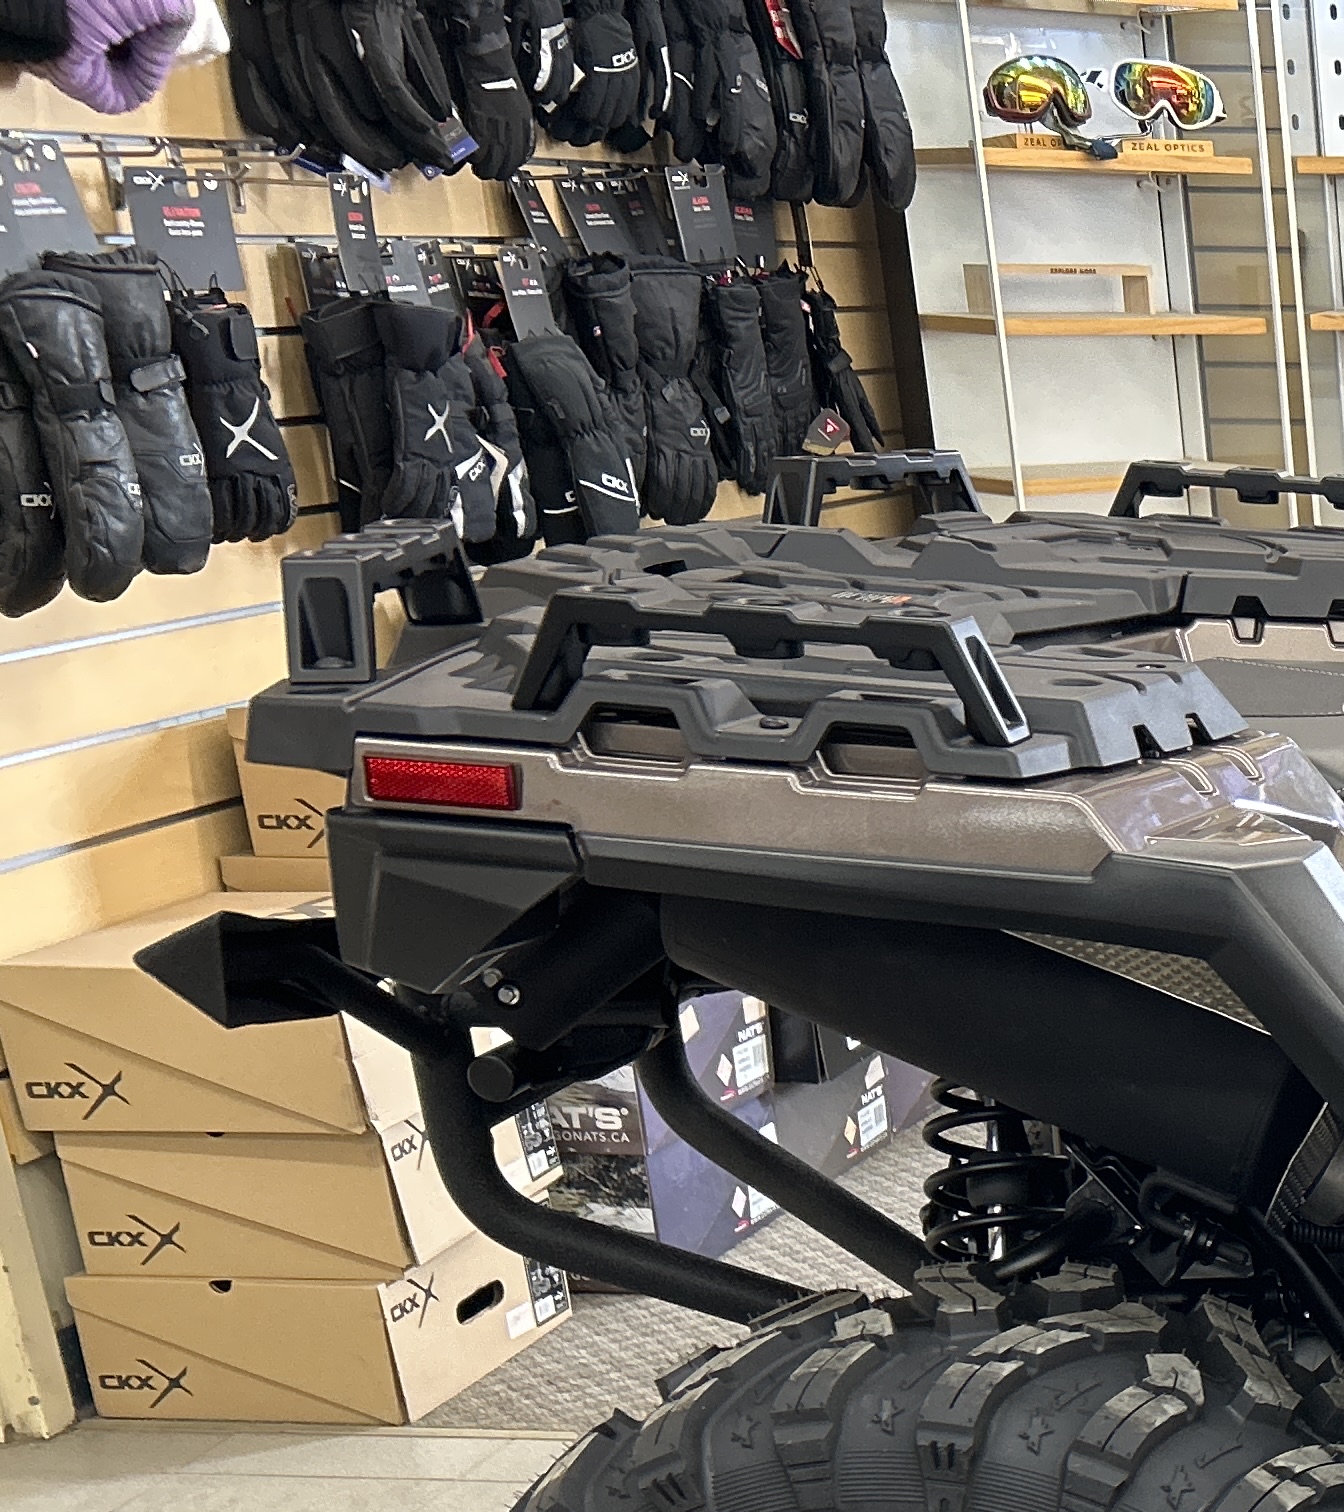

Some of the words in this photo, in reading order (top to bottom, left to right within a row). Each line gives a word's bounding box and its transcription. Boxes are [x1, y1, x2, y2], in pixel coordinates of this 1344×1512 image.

[1024, 138, 1047, 148] ZEAL
[1131, 142, 1161, 152] ZEAL
[1164, 143, 1205, 153] OPTICS
[602, 472, 630, 494] CKX
[257, 813, 316, 831] CKX
[25, 1081, 91, 1100] CKX
[551, 1106, 624, 1131] AT'S
[390, 1134, 419, 1163] CKX
[87, 1231, 149, 1248] CKX
[389, 1292, 421, 1323] CKX
[98, 1374, 158, 1391] CKX
